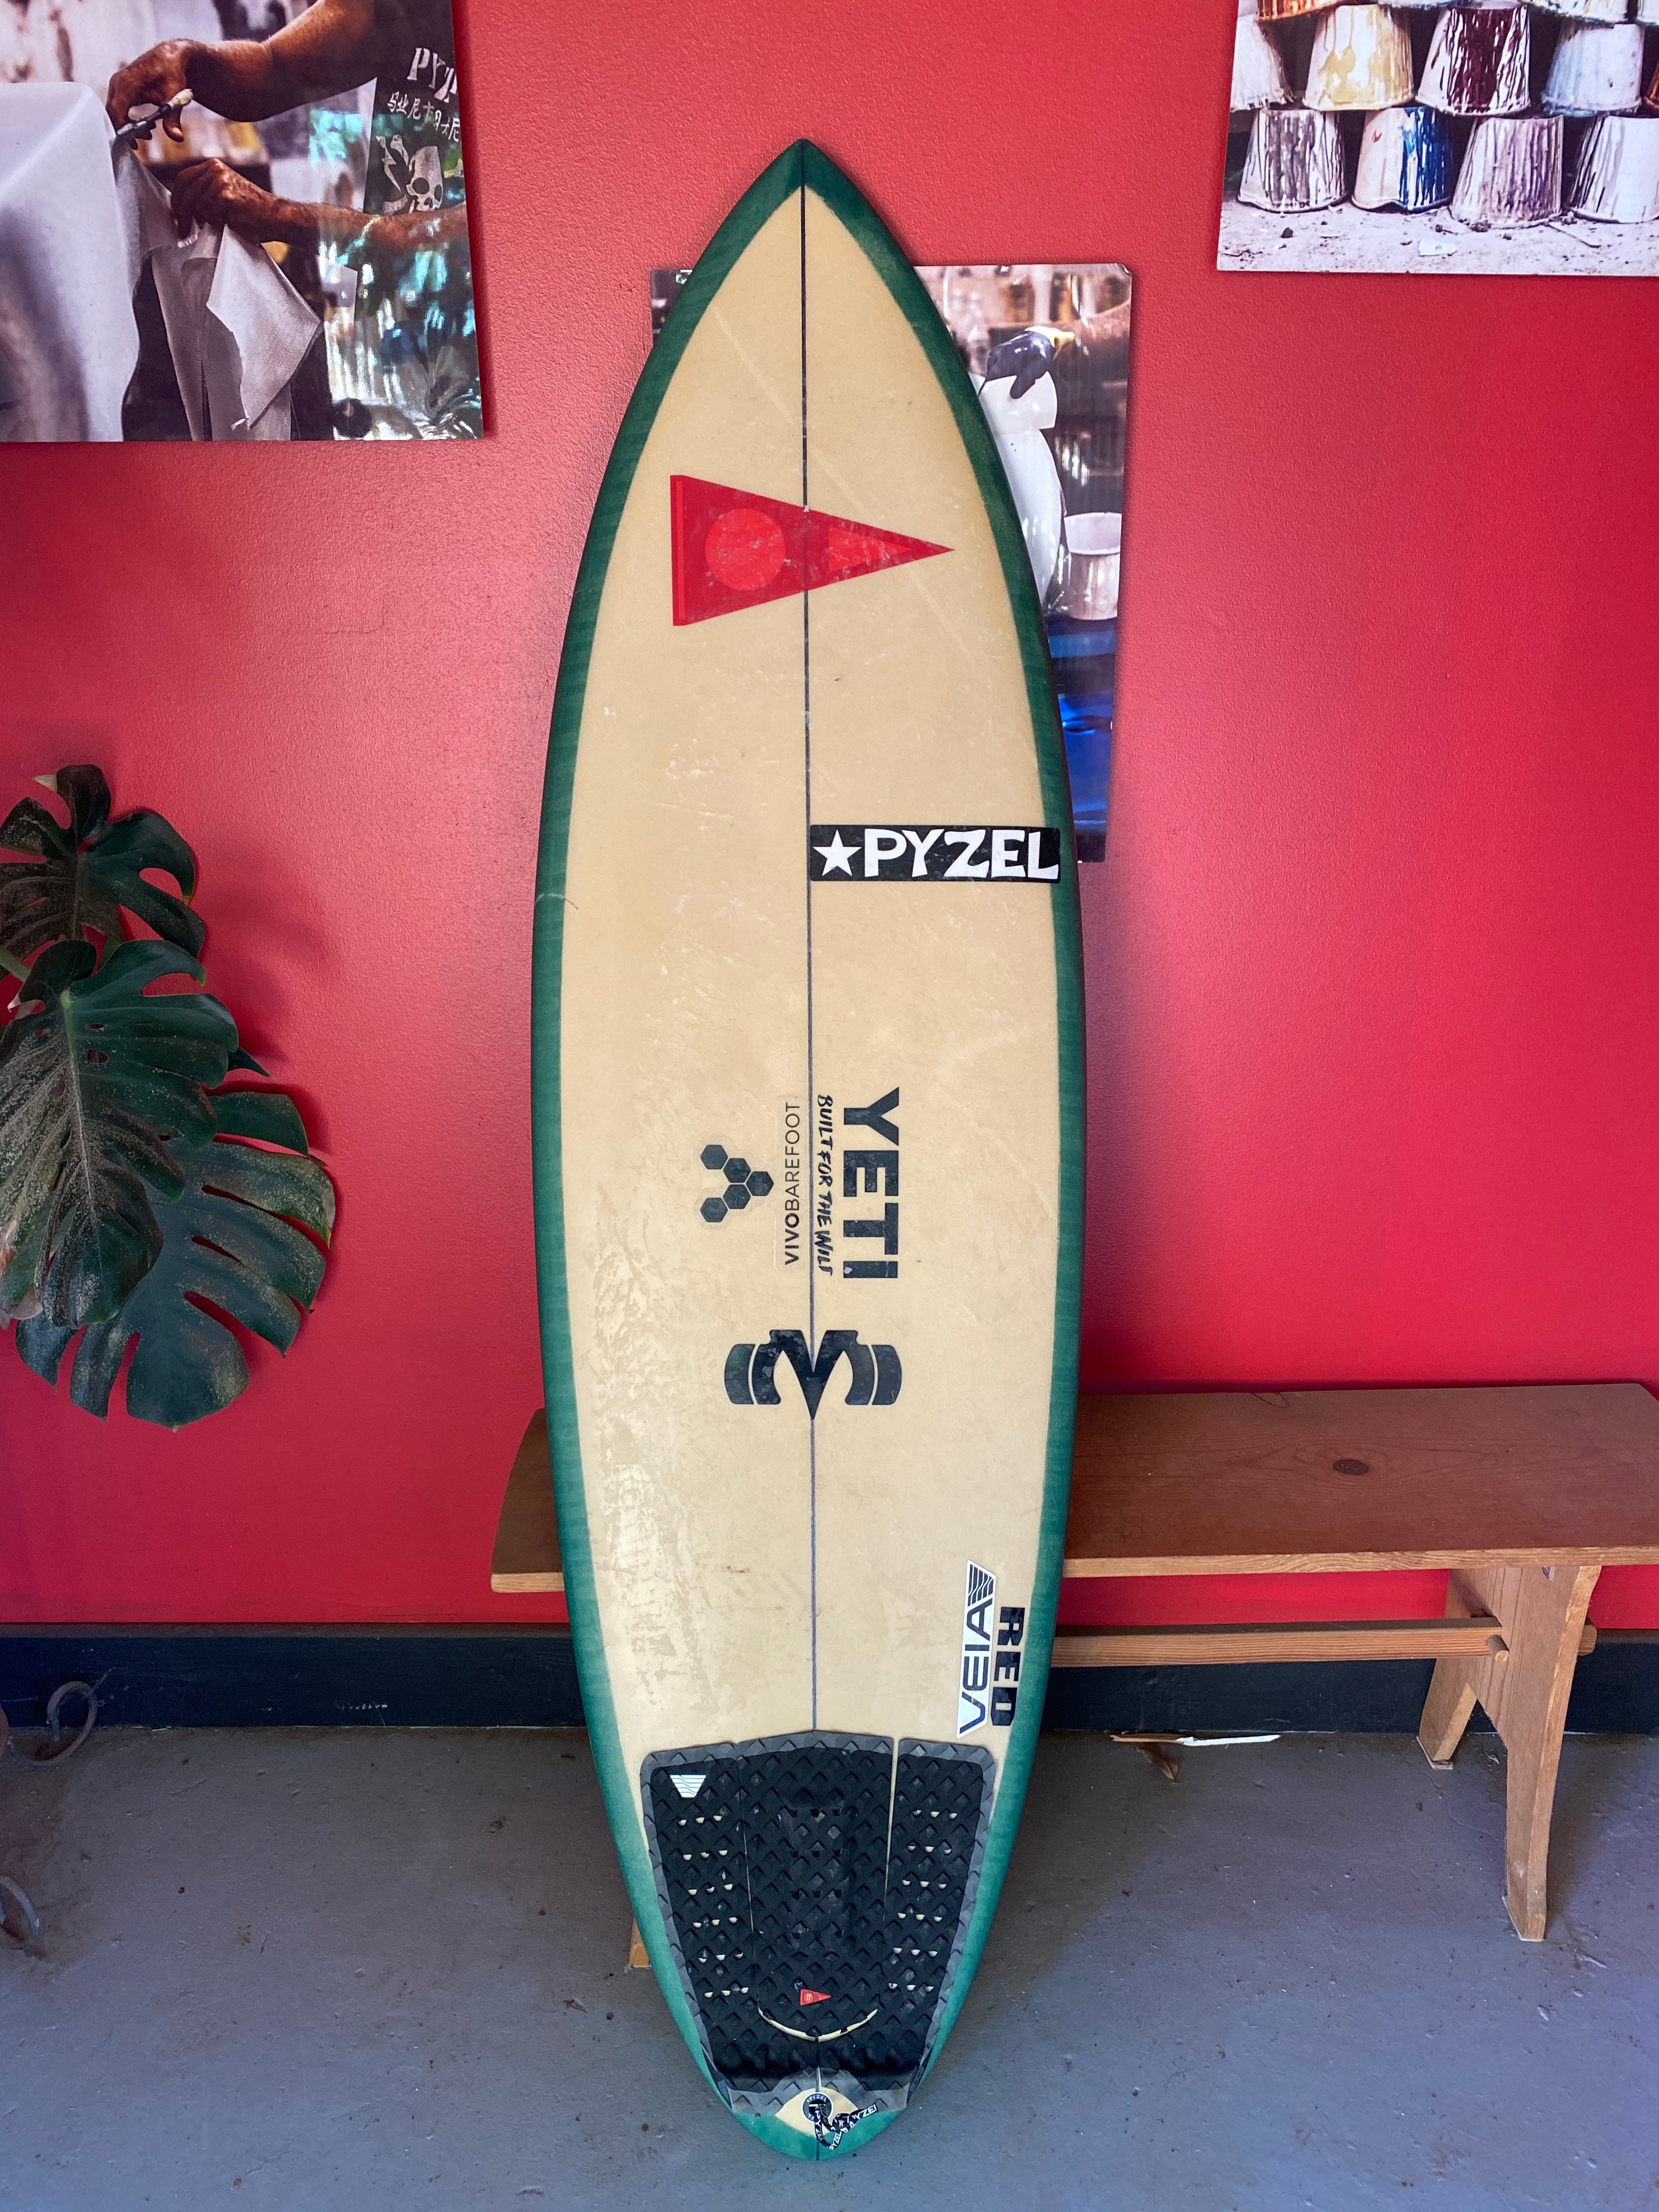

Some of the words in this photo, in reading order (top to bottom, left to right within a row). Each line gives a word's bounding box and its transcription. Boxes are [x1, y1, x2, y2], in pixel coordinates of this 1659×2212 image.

[864, 828, 1059, 880] PYZEL
[817, 1094, 833, 1150] BUILT
[785, 1102, 800, 1266] VIVOBAREFOOT
[817, 1150, 833, 1187] FOR
[817, 1190, 833, 1228] THE
[843, 1086, 900, 1279] YETI
[959, 1597, 993, 1735] VEIA
[990, 1606, 1025, 1726] RED
